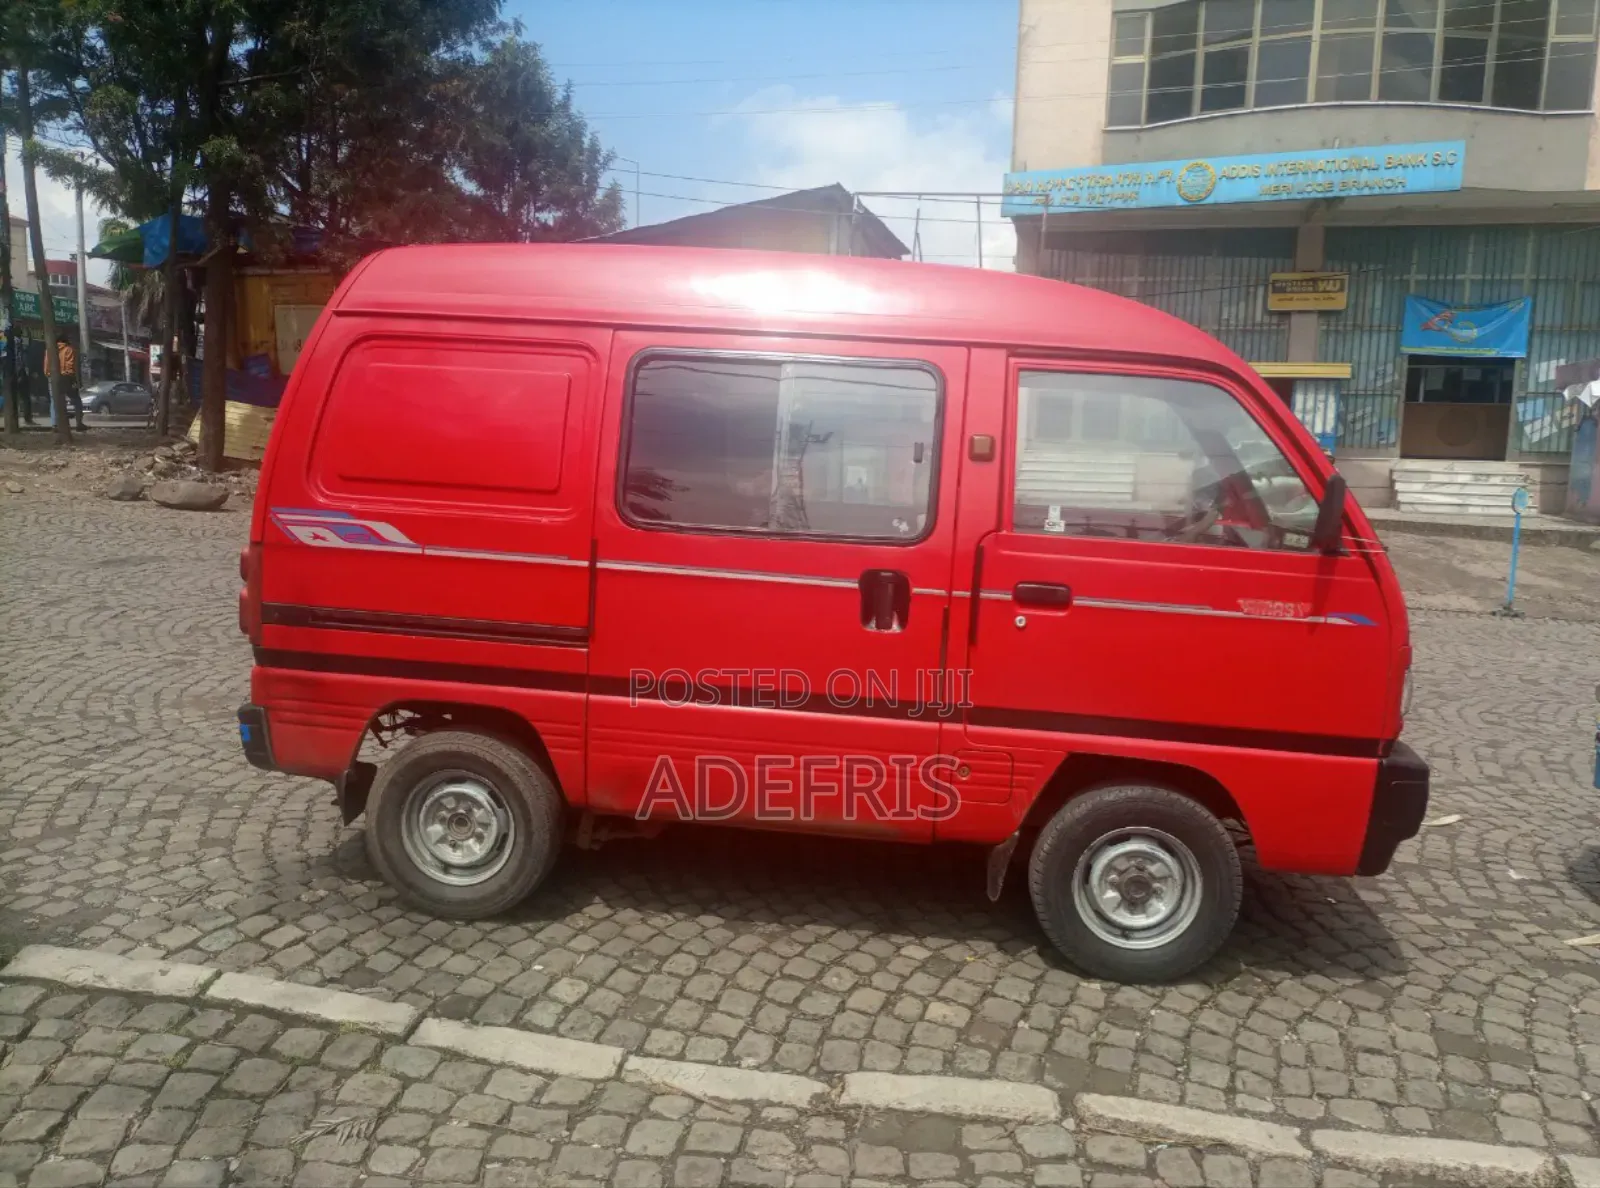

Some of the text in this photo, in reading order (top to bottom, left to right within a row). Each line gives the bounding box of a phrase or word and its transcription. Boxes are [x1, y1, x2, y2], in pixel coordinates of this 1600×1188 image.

[1219, 163, 1261, 179] ADDIS
[1265, 155, 1379, 176] INTERNATIONAL
[1384, 152, 1427, 169] BANK
[1338, 176, 1407, 191] BRANCH
